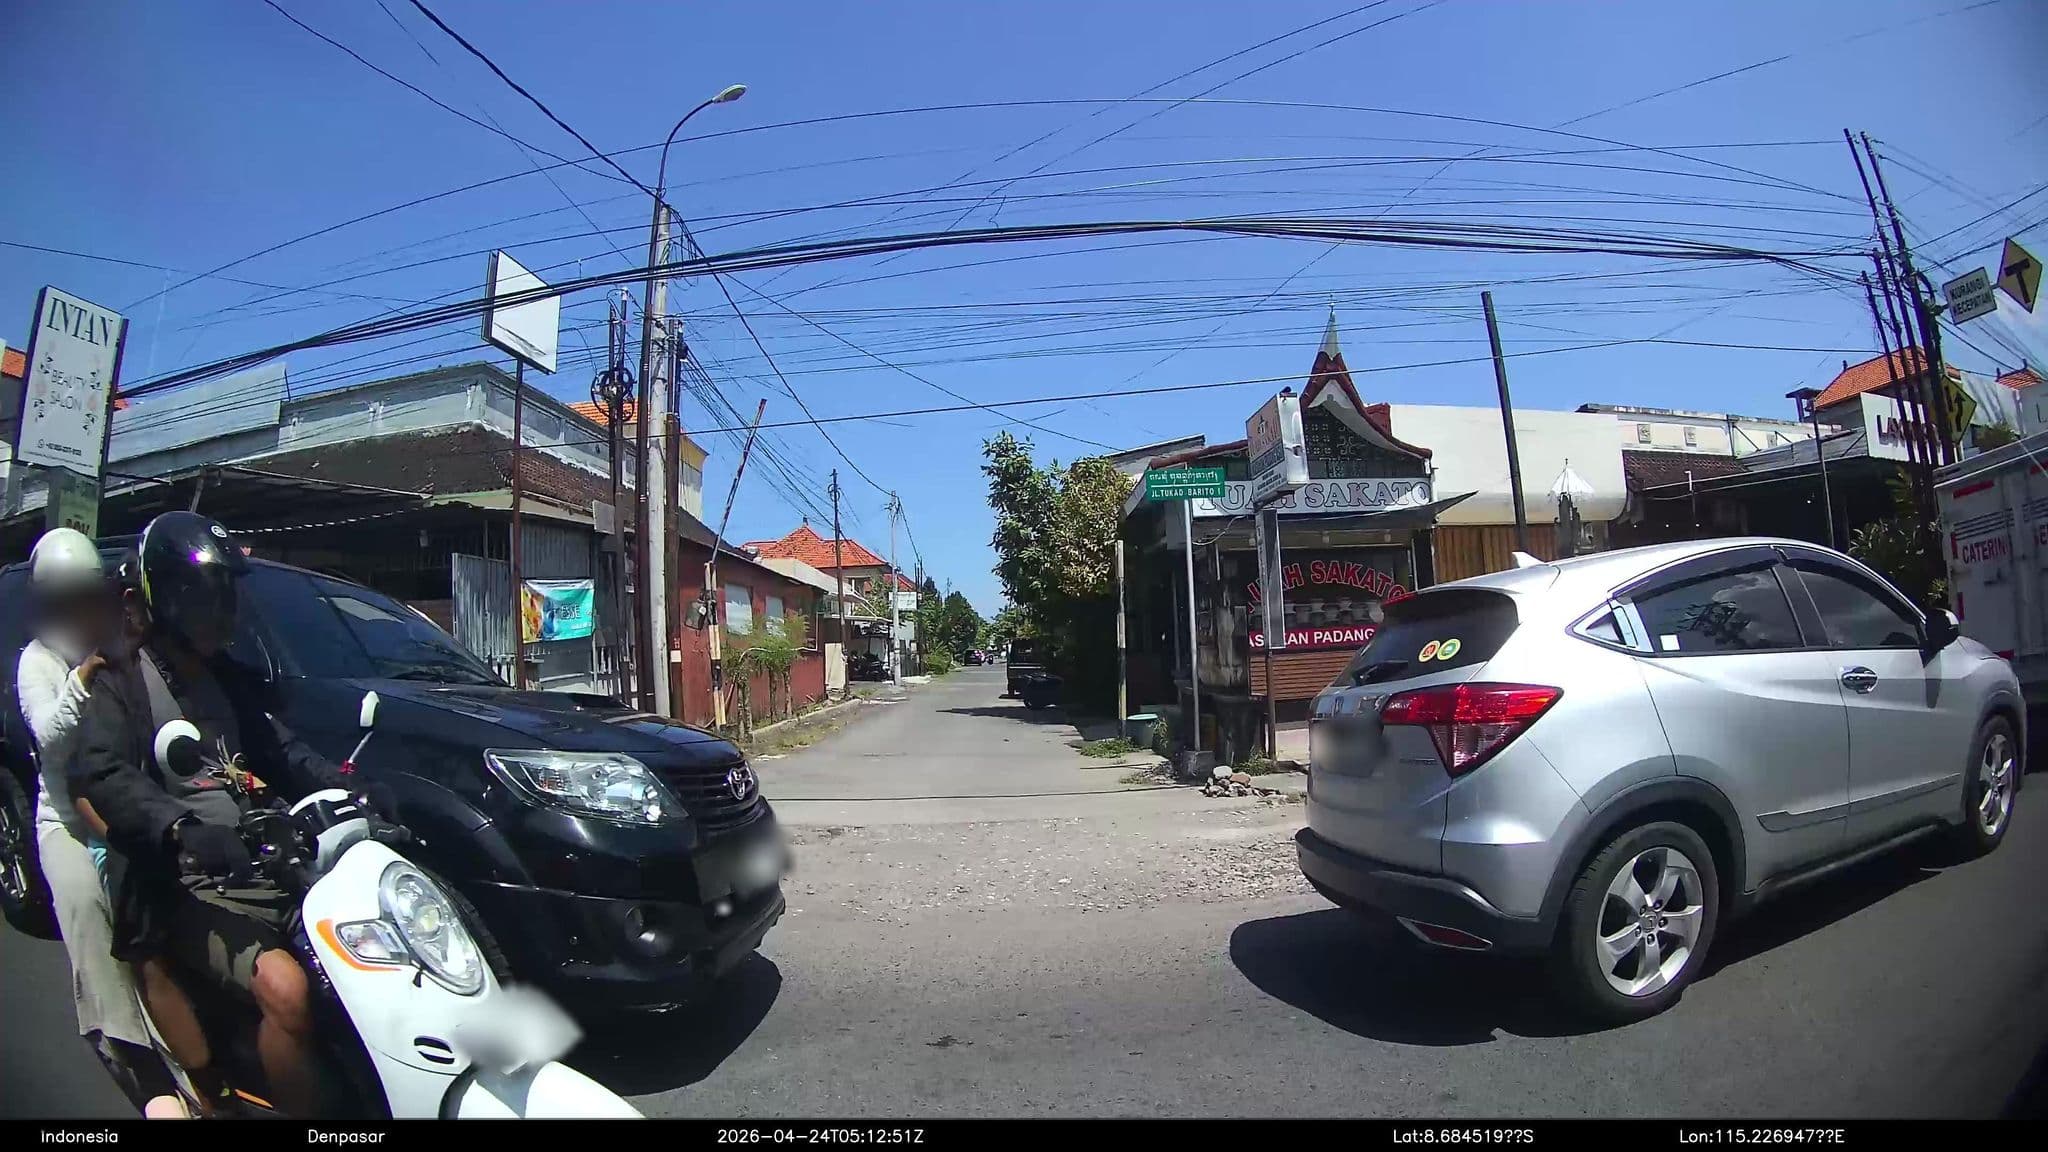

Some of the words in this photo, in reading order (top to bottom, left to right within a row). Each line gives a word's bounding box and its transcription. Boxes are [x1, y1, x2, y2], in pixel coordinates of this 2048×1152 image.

[1950, 278, 1985, 300] KURANGI
[46, 297, 113, 347] INTAN
[51, 369, 87, 389] BEAUTY
[49, 390, 81, 411] SALON
[1187, 487, 1215, 496] BARITO
[1304, 482, 1430, 508] SAKATO
[1311, 560, 1407, 602] SAKATO
